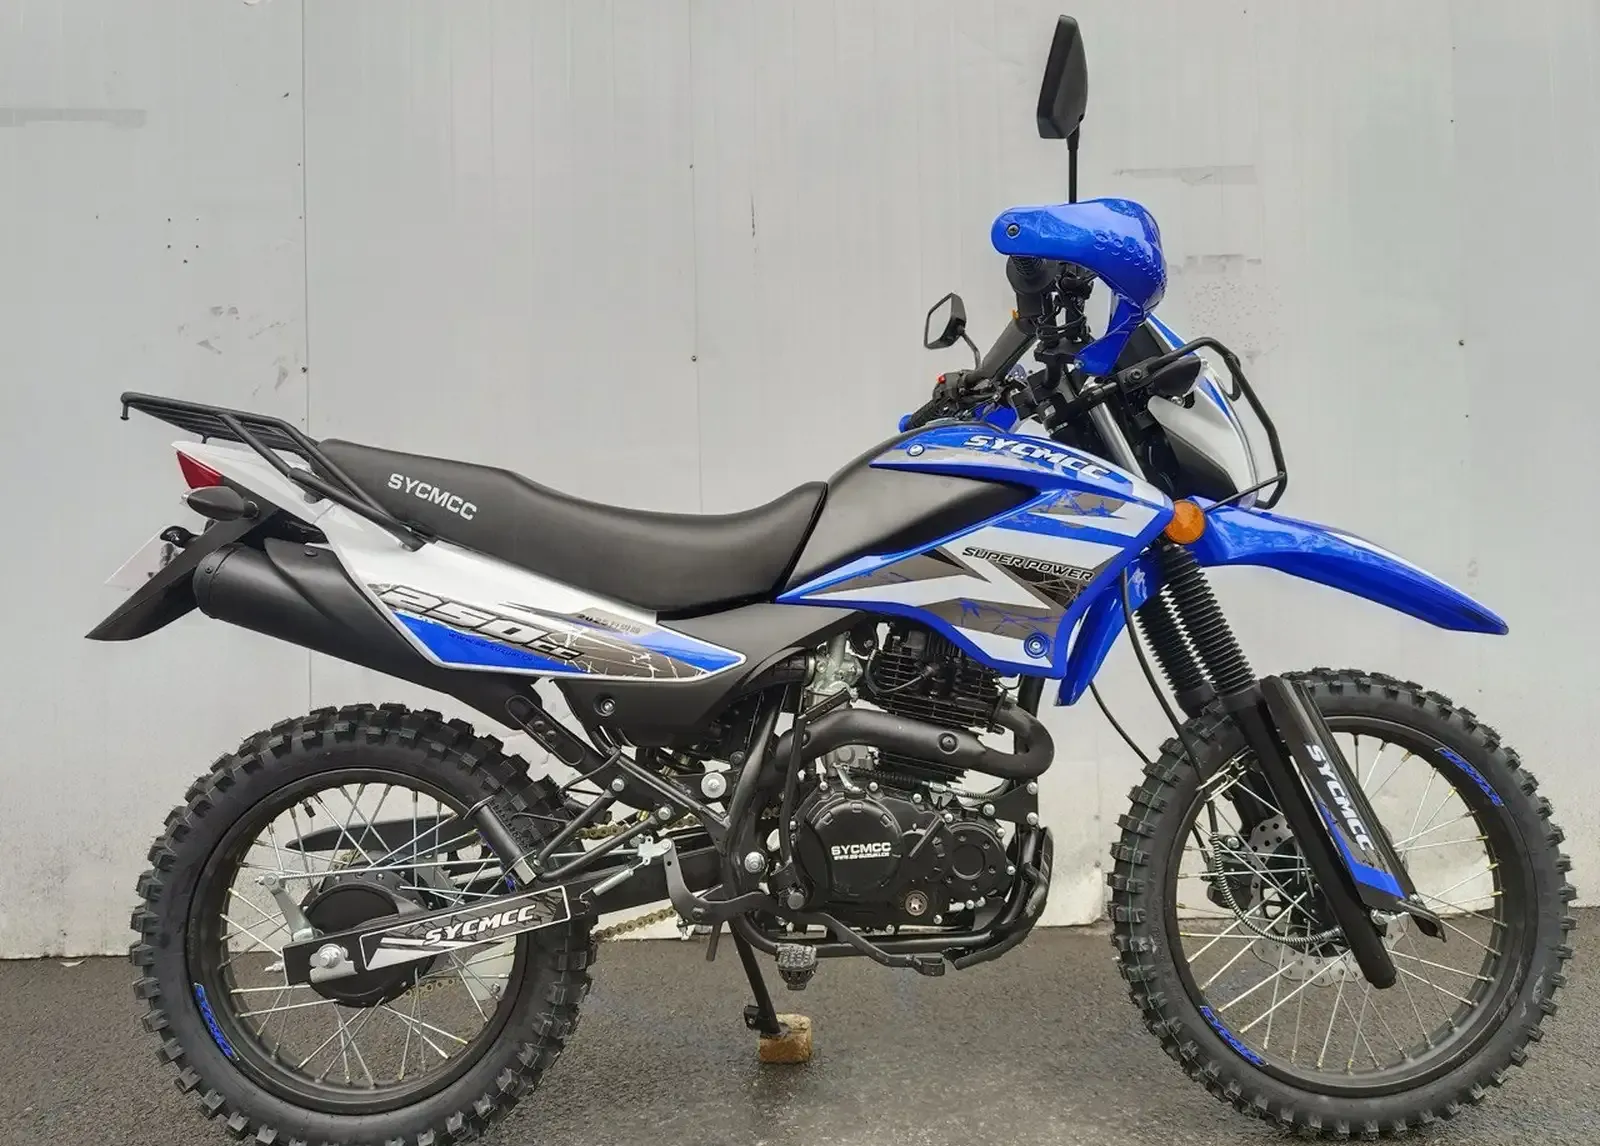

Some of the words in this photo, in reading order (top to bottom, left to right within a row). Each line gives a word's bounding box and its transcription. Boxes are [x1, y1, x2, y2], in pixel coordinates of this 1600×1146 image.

[964, 435, 1110, 480] SYCMCC
[388, 473, 477, 520] SYCMCC
[962, 545, 1024, 568] SUPER
[1024, 558, 1096, 582] POWER
[1305, 744, 1375, 851] SYCMCC
[831, 842, 892, 856] SYCMCC
[423, 904, 537, 946] SYCMCC
